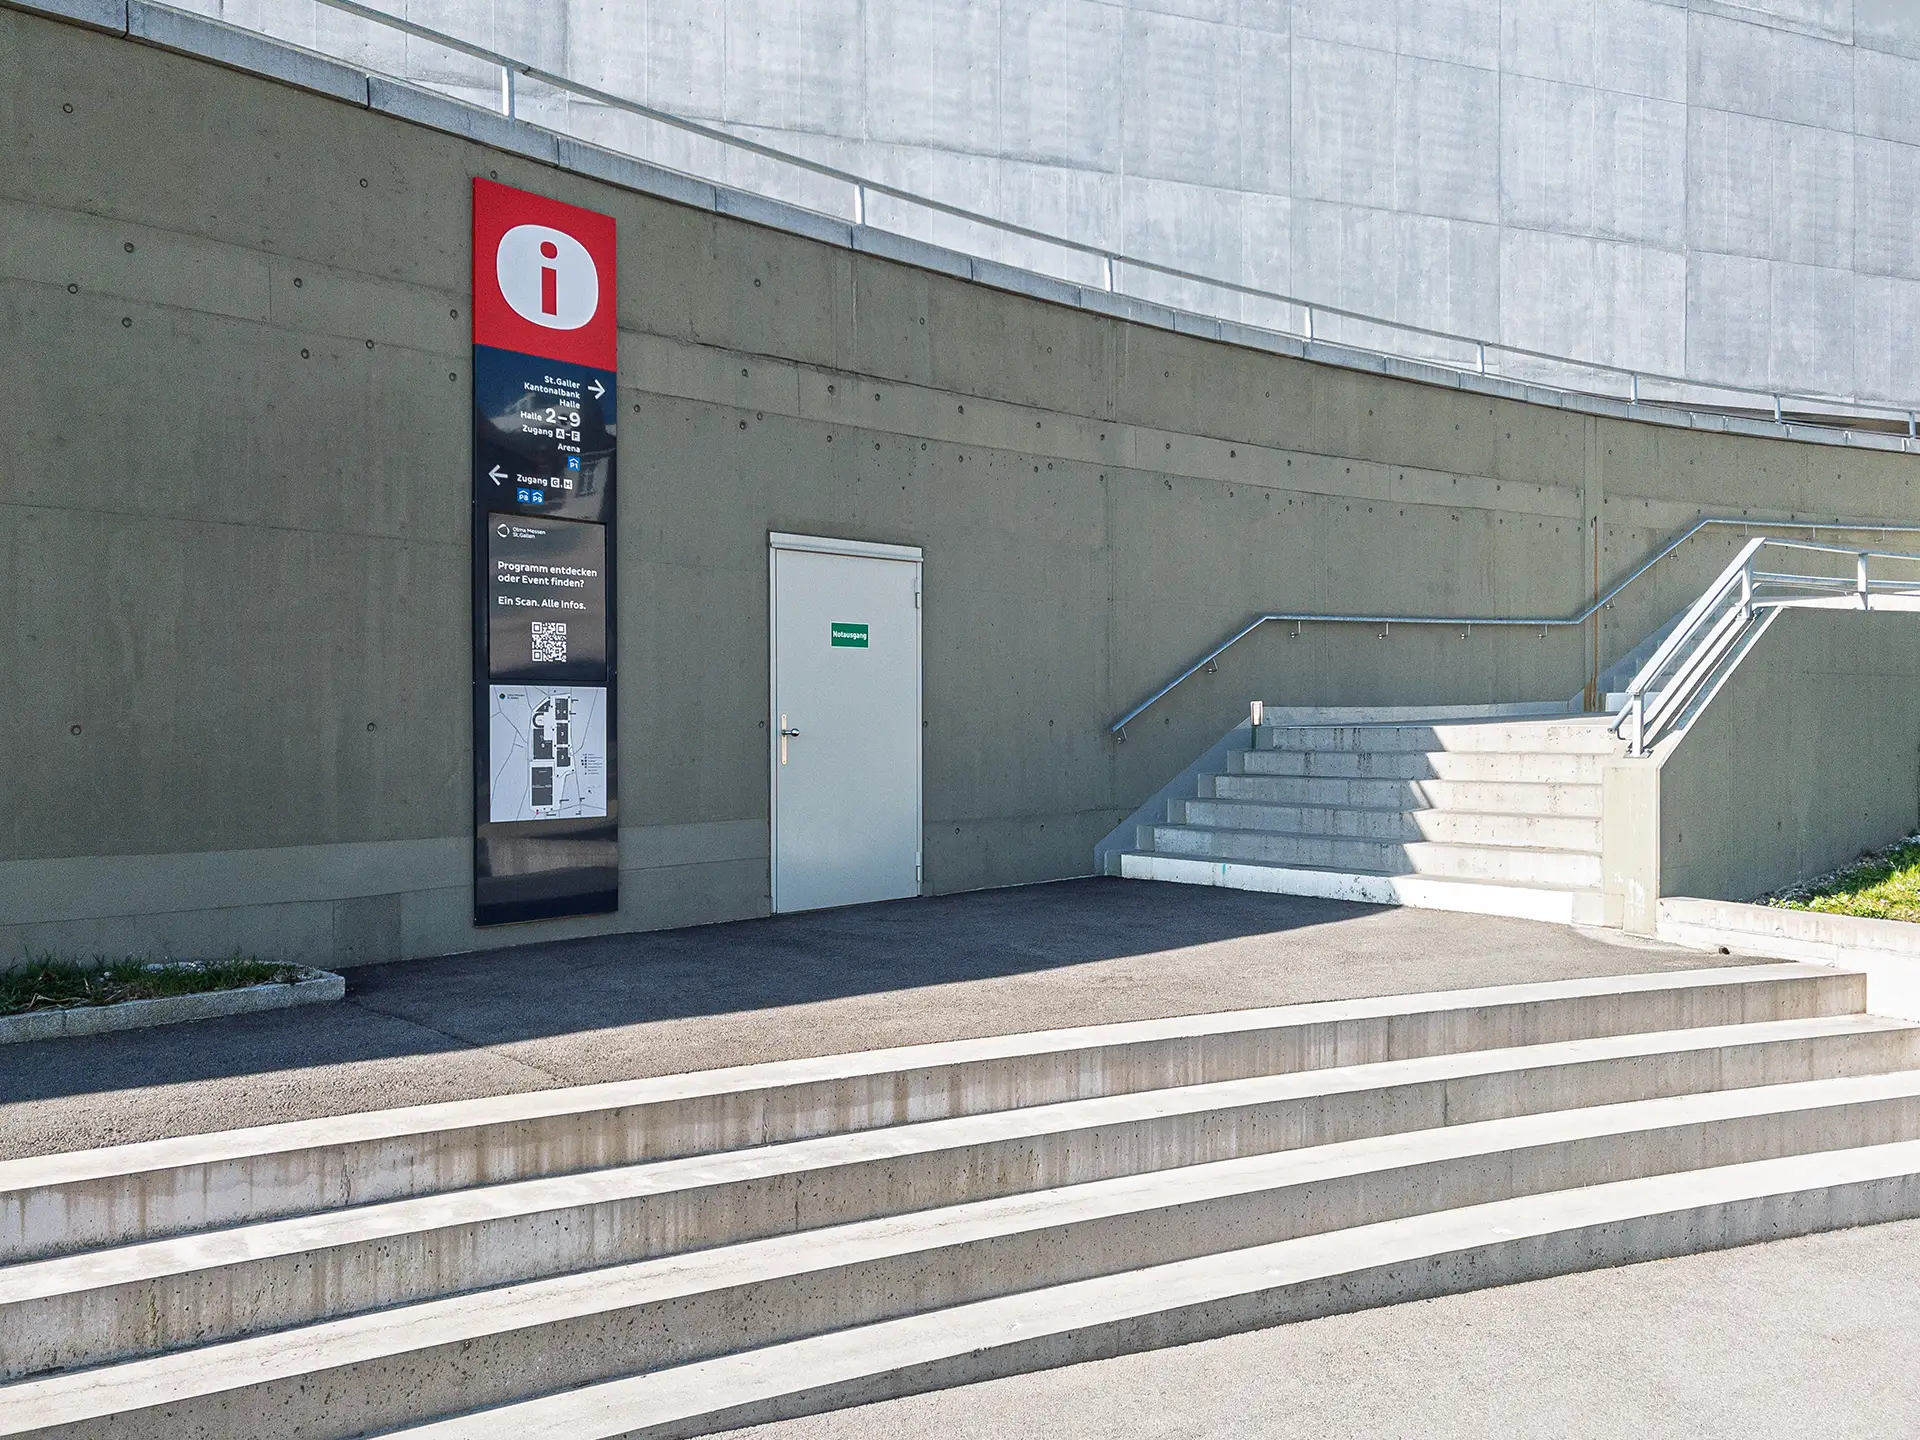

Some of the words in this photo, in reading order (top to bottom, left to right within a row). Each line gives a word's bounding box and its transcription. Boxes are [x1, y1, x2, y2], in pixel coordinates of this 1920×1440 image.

[524, 382, 580, 399] Kantonalbank
[559, 399, 580, 409] Halle
[520, 411, 542, 421] Halle
[522, 424, 553, 437] Zugang
[557, 443, 580, 453] Arena
[516, 474, 548, 487] Zugang
[497, 561, 549, 573] Programm
[549, 566, 597, 577] entdecken
[497, 574, 520, 583] oder
[521, 575, 550, 586] Event
[550, 577, 585, 588] finden?
[498, 596, 514, 606] Ein
[515, 597, 540, 607] Scan.
[541, 599, 560, 608] Alle
[561, 601, 587, 610] Infos.
[832, 630, 867, 641] Notausgang
